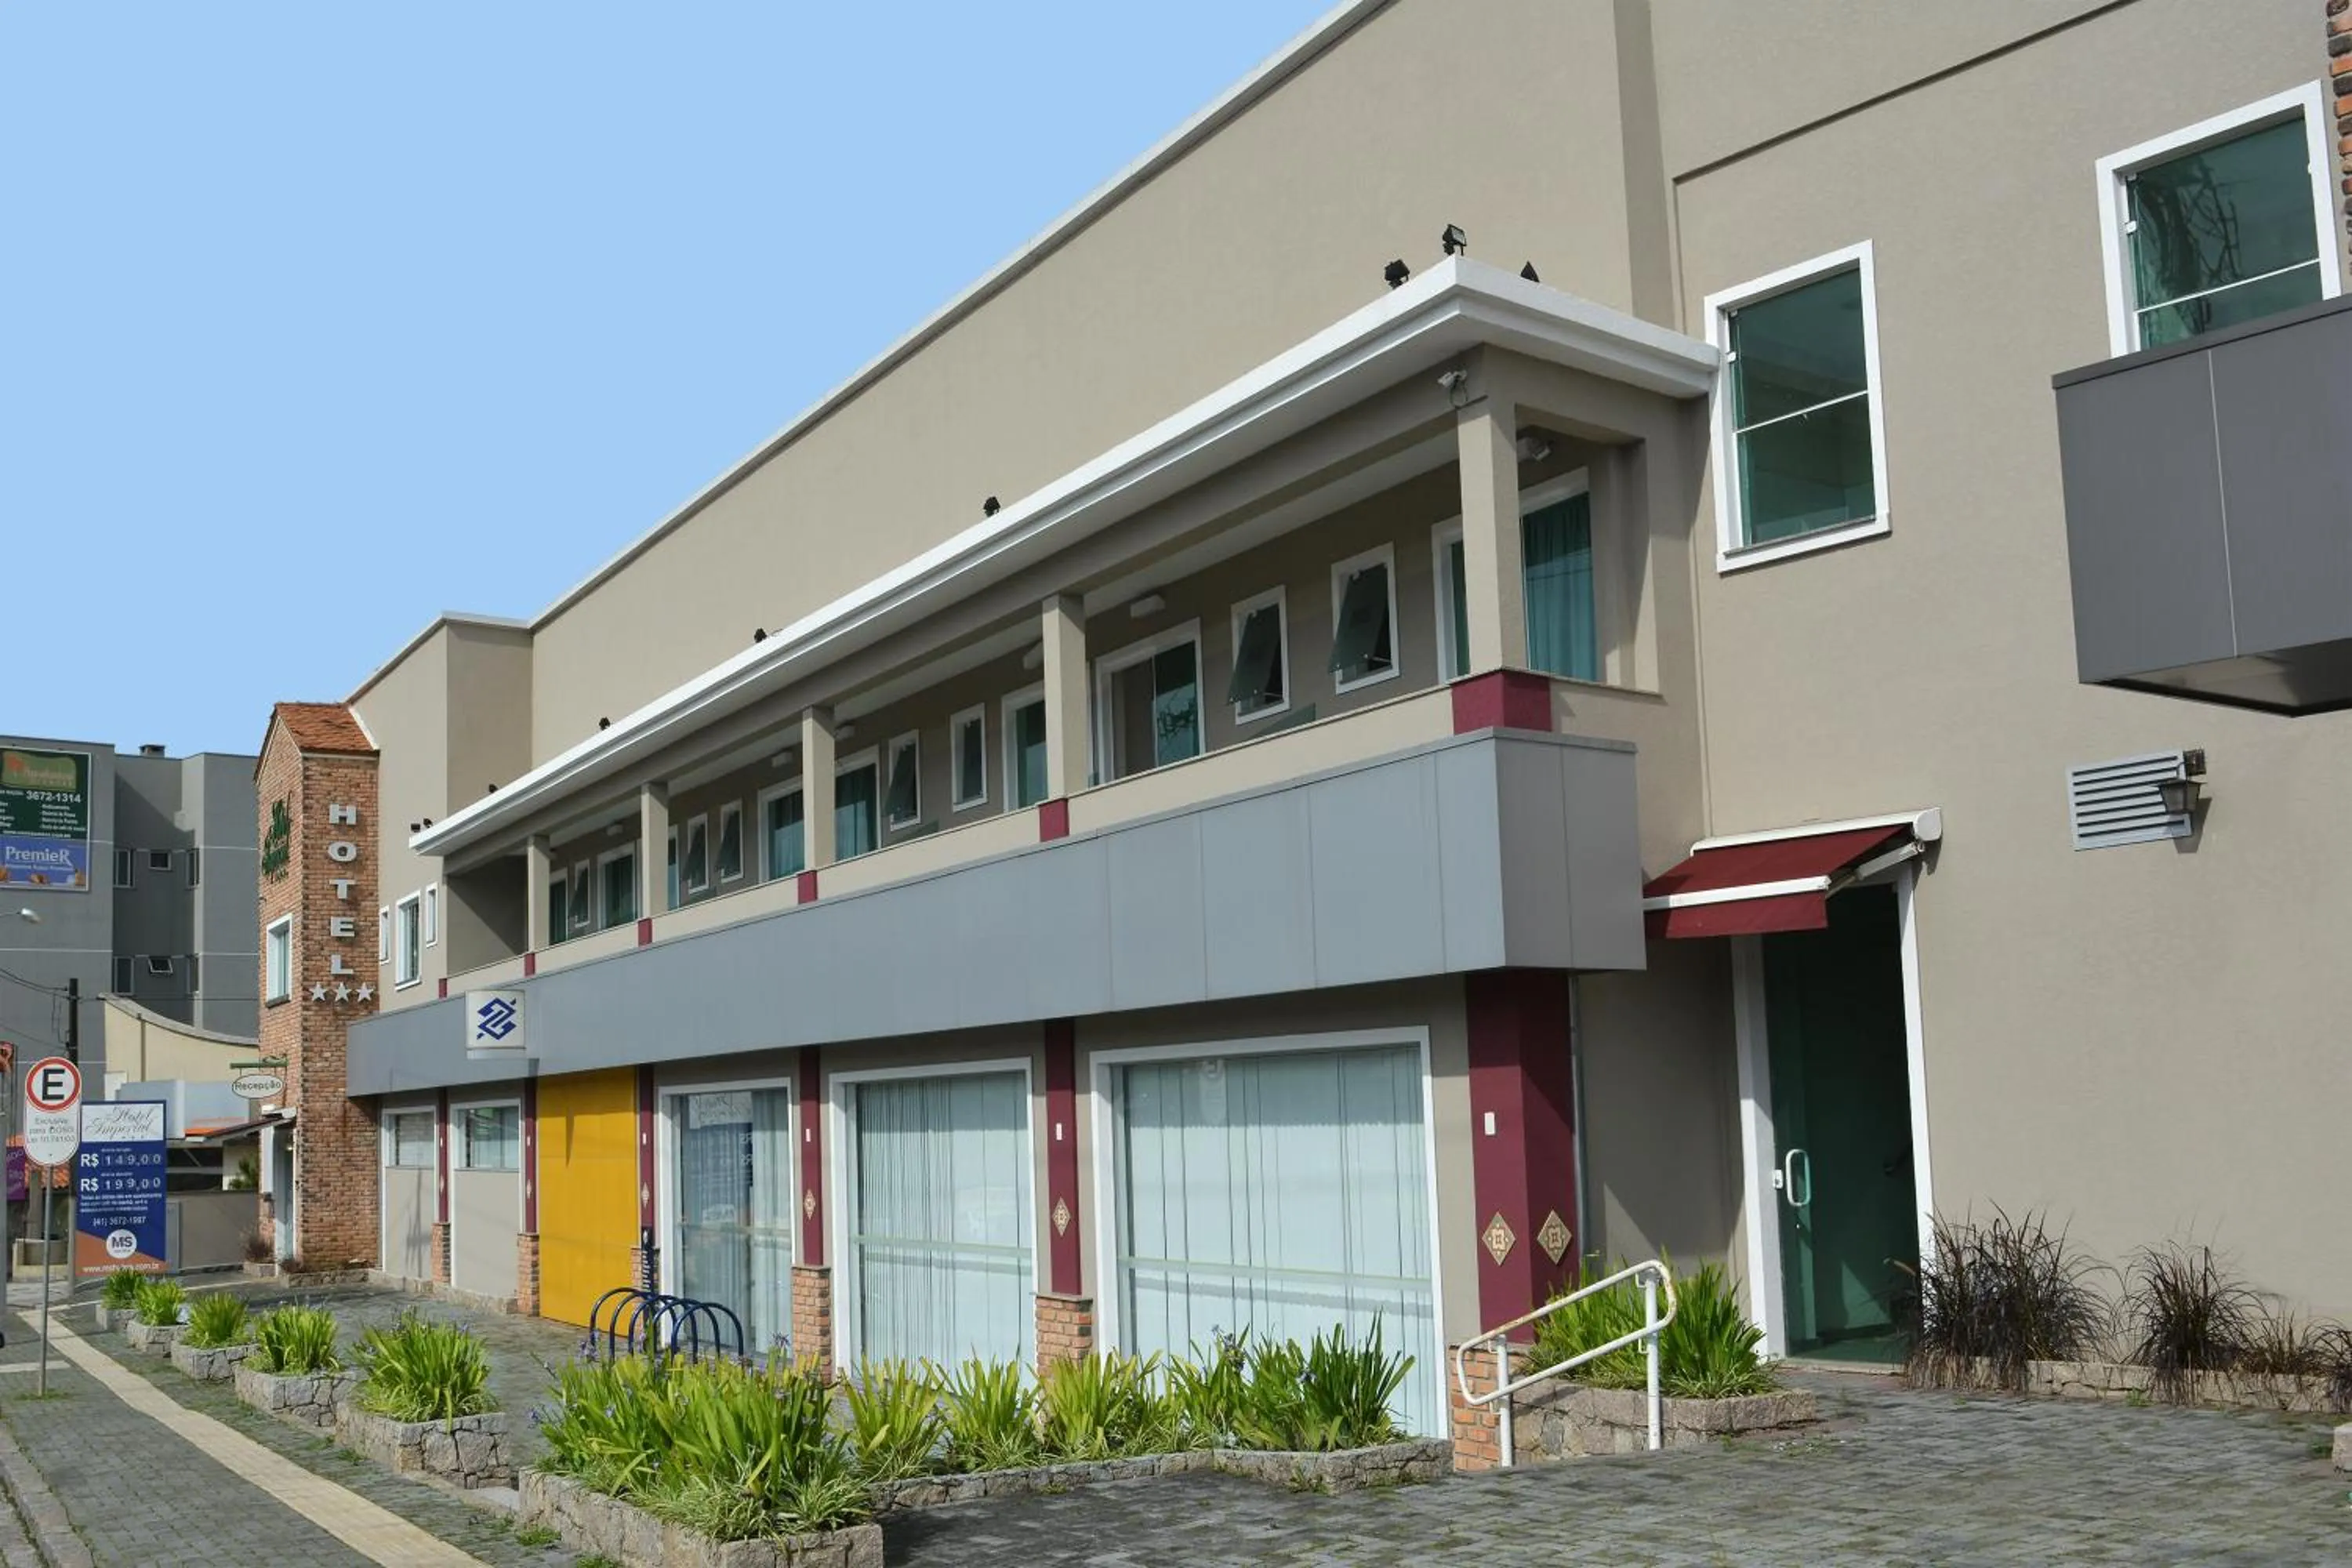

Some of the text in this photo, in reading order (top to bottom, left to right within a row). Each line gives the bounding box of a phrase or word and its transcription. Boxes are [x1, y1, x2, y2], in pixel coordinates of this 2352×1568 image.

[26, 789, 81, 804] 3672-1314
[5, 846, 74, 866] PremieR
[328, 804, 358, 975] HOTEL
[42, 1069, 65, 1100] E
[235, 1080, 281, 1091] Recepção
[81, 1153, 161, 1168] R$ 149,00
[81, 1178, 161, 1192] R$ 199,00
[112, 1236, 132, 1248] MS
